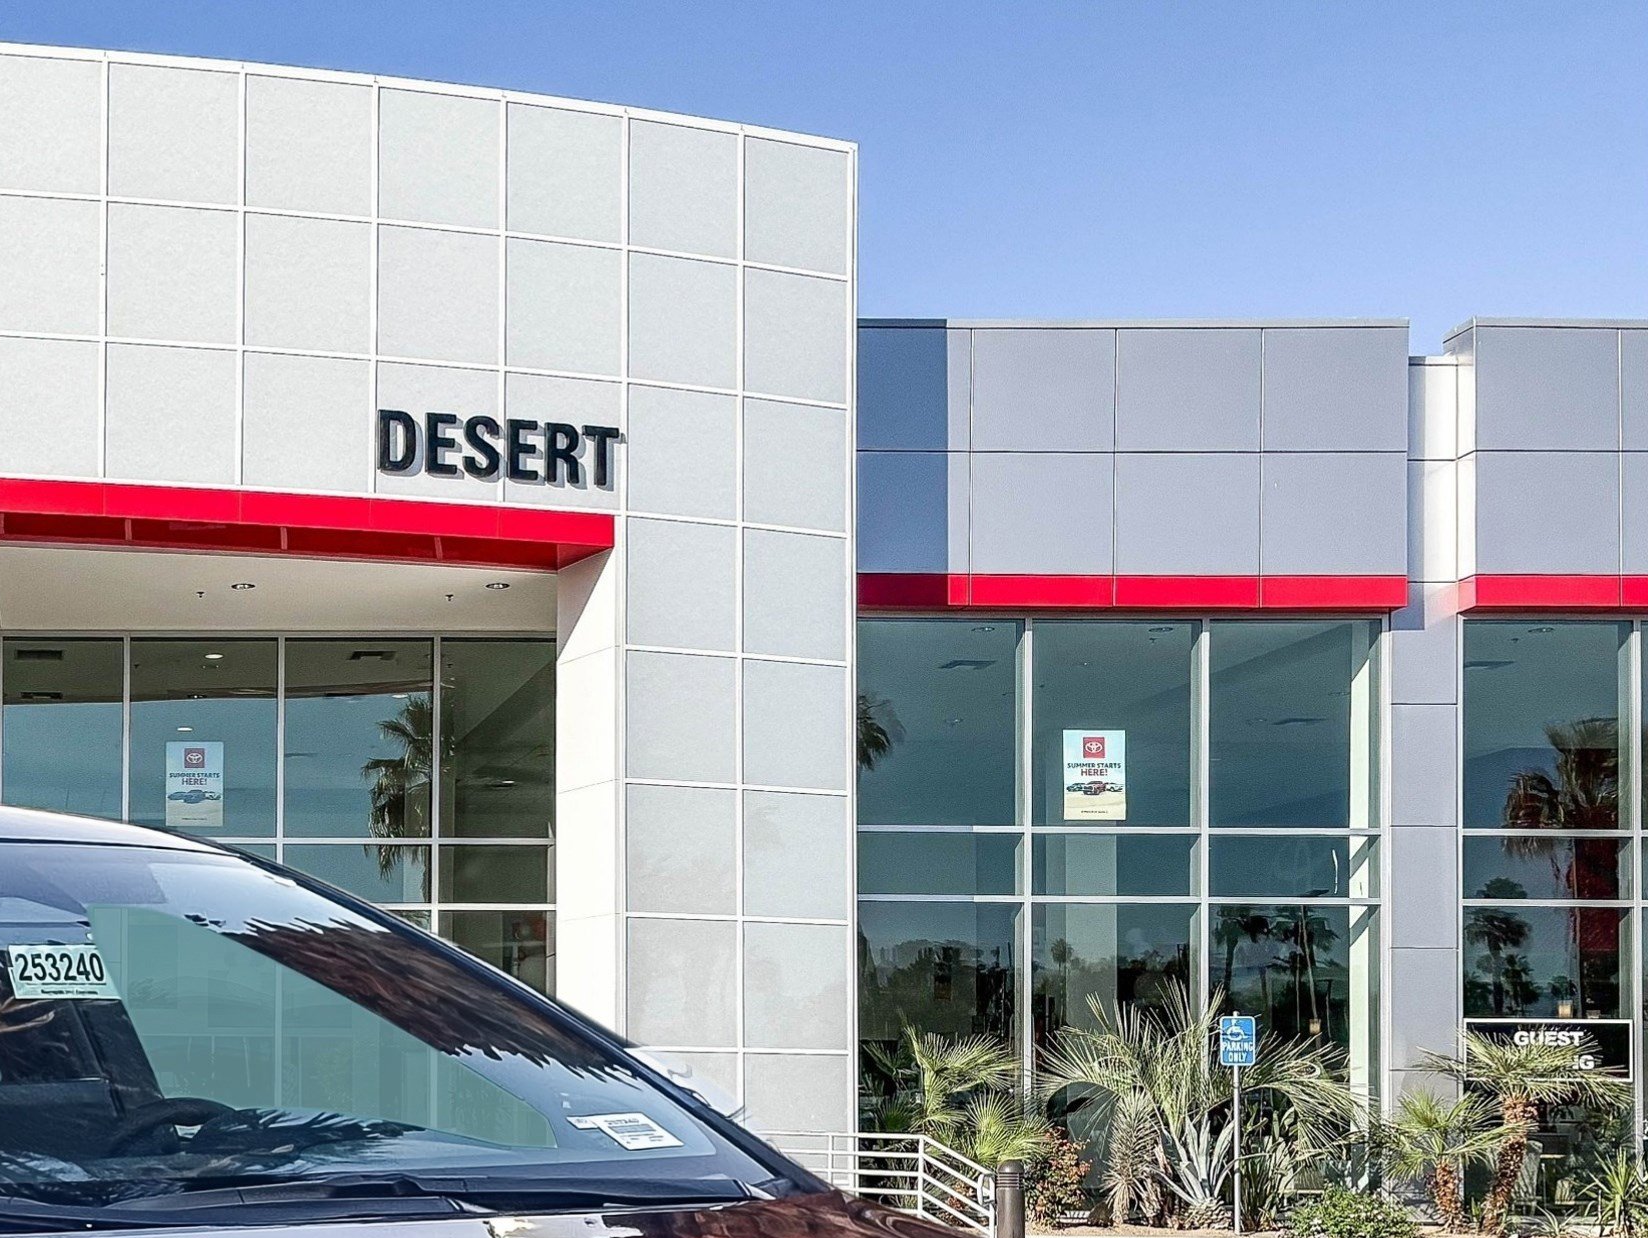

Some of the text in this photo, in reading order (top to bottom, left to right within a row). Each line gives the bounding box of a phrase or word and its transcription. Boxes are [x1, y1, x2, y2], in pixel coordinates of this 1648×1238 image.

[377, 409, 620, 487] DESERT
[1080, 768, 1108, 776] HERE!
[181, 778, 207, 786] HERE!
[14, 952, 105, 982] 253240
[1514, 1030, 1584, 1046] GUEST
[1222, 1041, 1253, 1051] PARKING
[1228, 1052, 1247, 1062] ONLY
